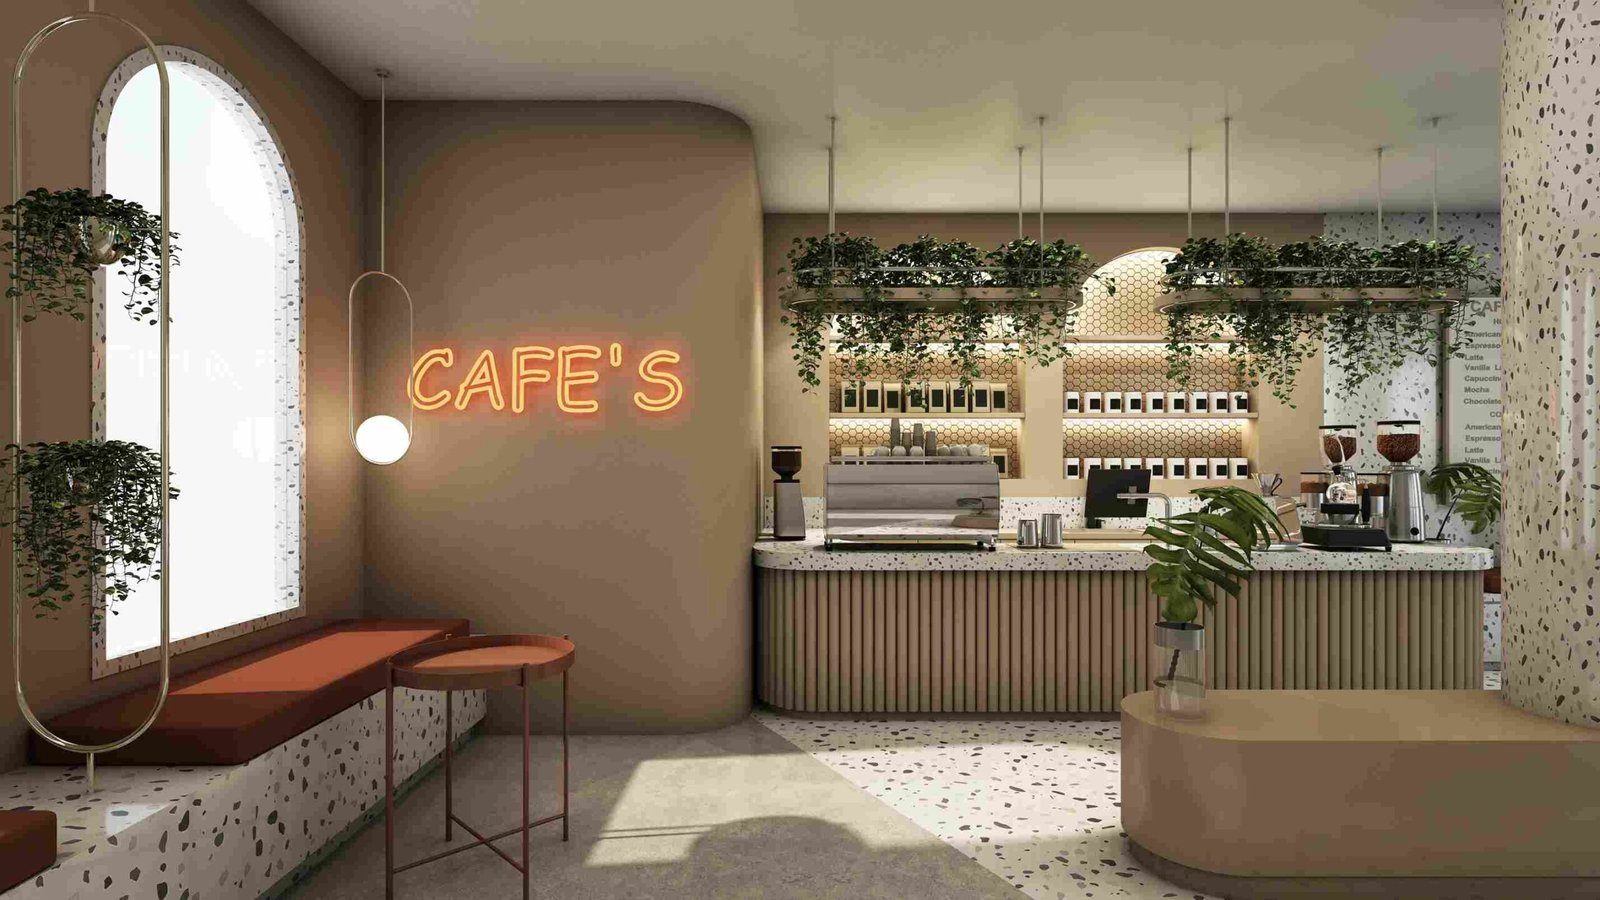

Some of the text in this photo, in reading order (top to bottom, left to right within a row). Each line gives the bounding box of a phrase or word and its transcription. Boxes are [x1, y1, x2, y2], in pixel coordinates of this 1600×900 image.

[1464, 353, 1484, 361] Latte
[407, 343, 683, 413] CAFE'S
[1465, 434, 1502, 443] Espresso
[1464, 446, 1484, 454] Latte
